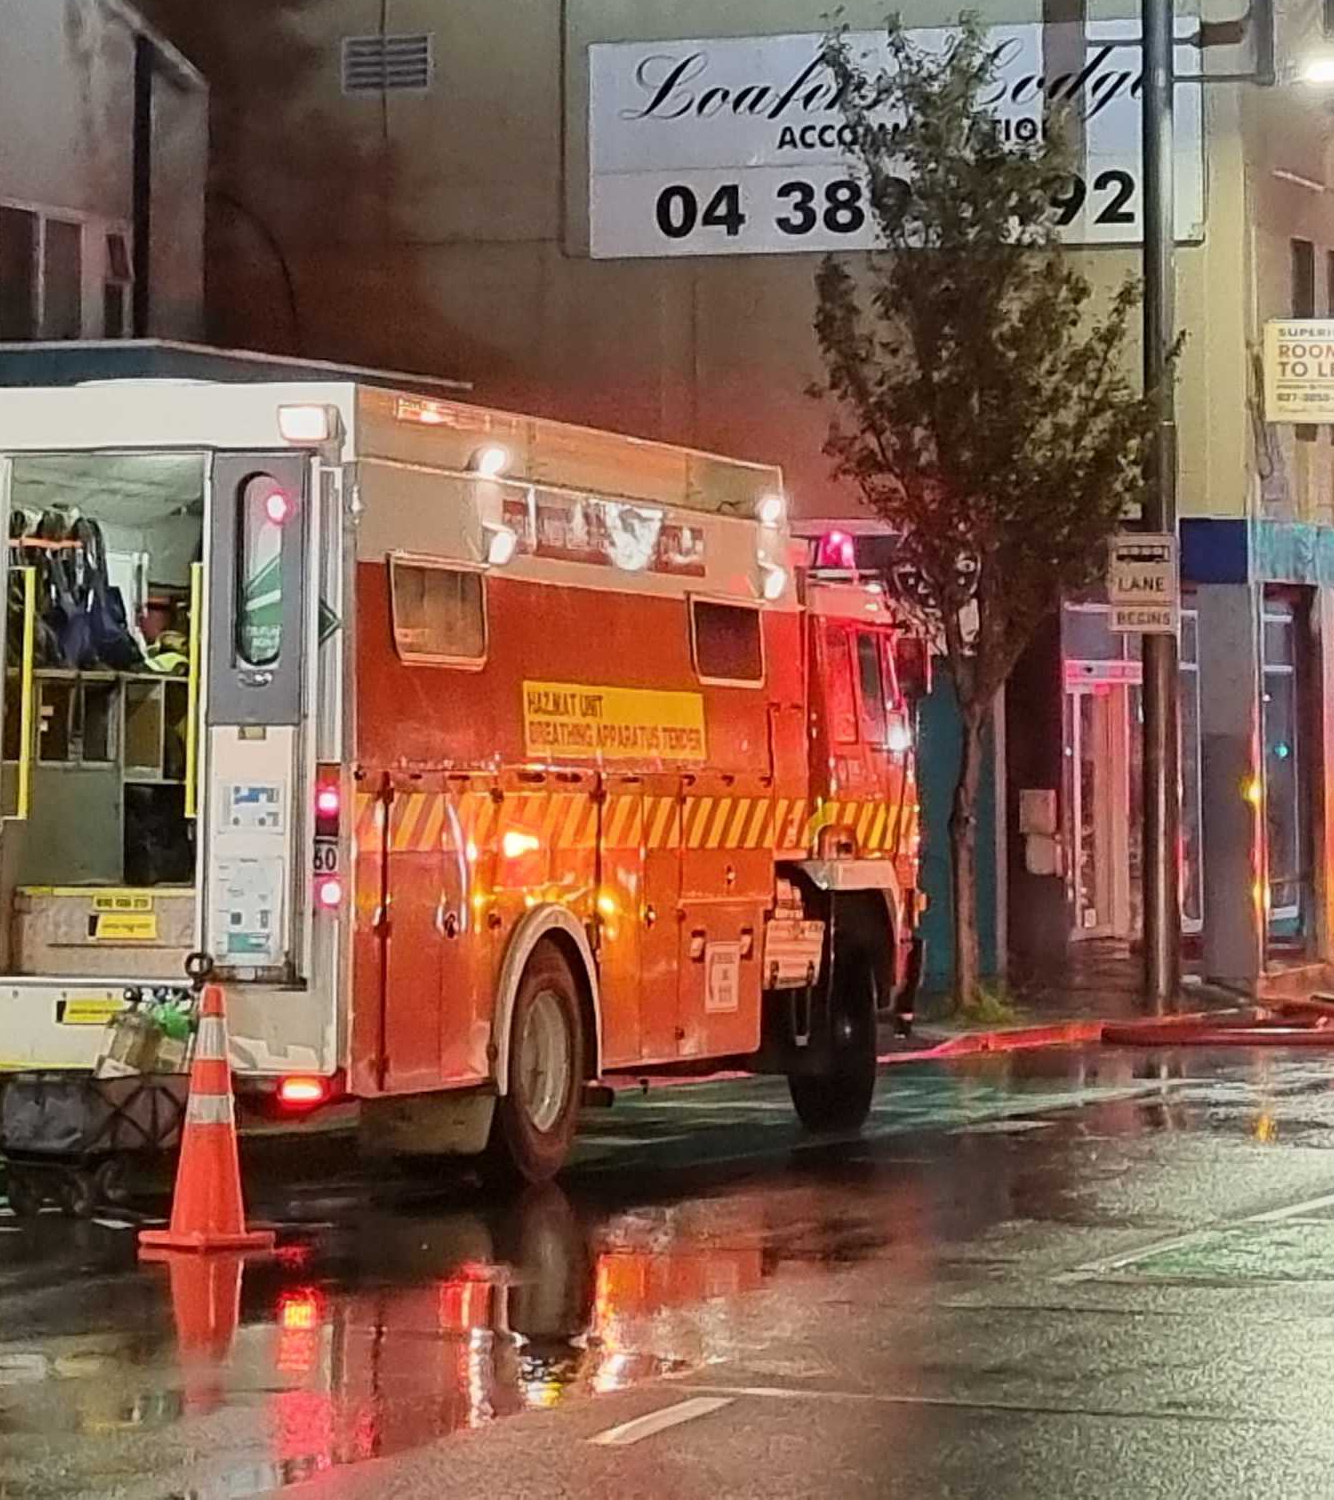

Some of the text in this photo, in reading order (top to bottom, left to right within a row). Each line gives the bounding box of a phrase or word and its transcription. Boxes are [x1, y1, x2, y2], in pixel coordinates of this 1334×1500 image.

[656, 184, 746, 238] 04
[1278, 361, 1308, 378] TO
[1118, 576, 1164, 592] LANE
[1117, 611, 1170, 625] BEGINS
[528, 691, 576, 717] HAZMAT
